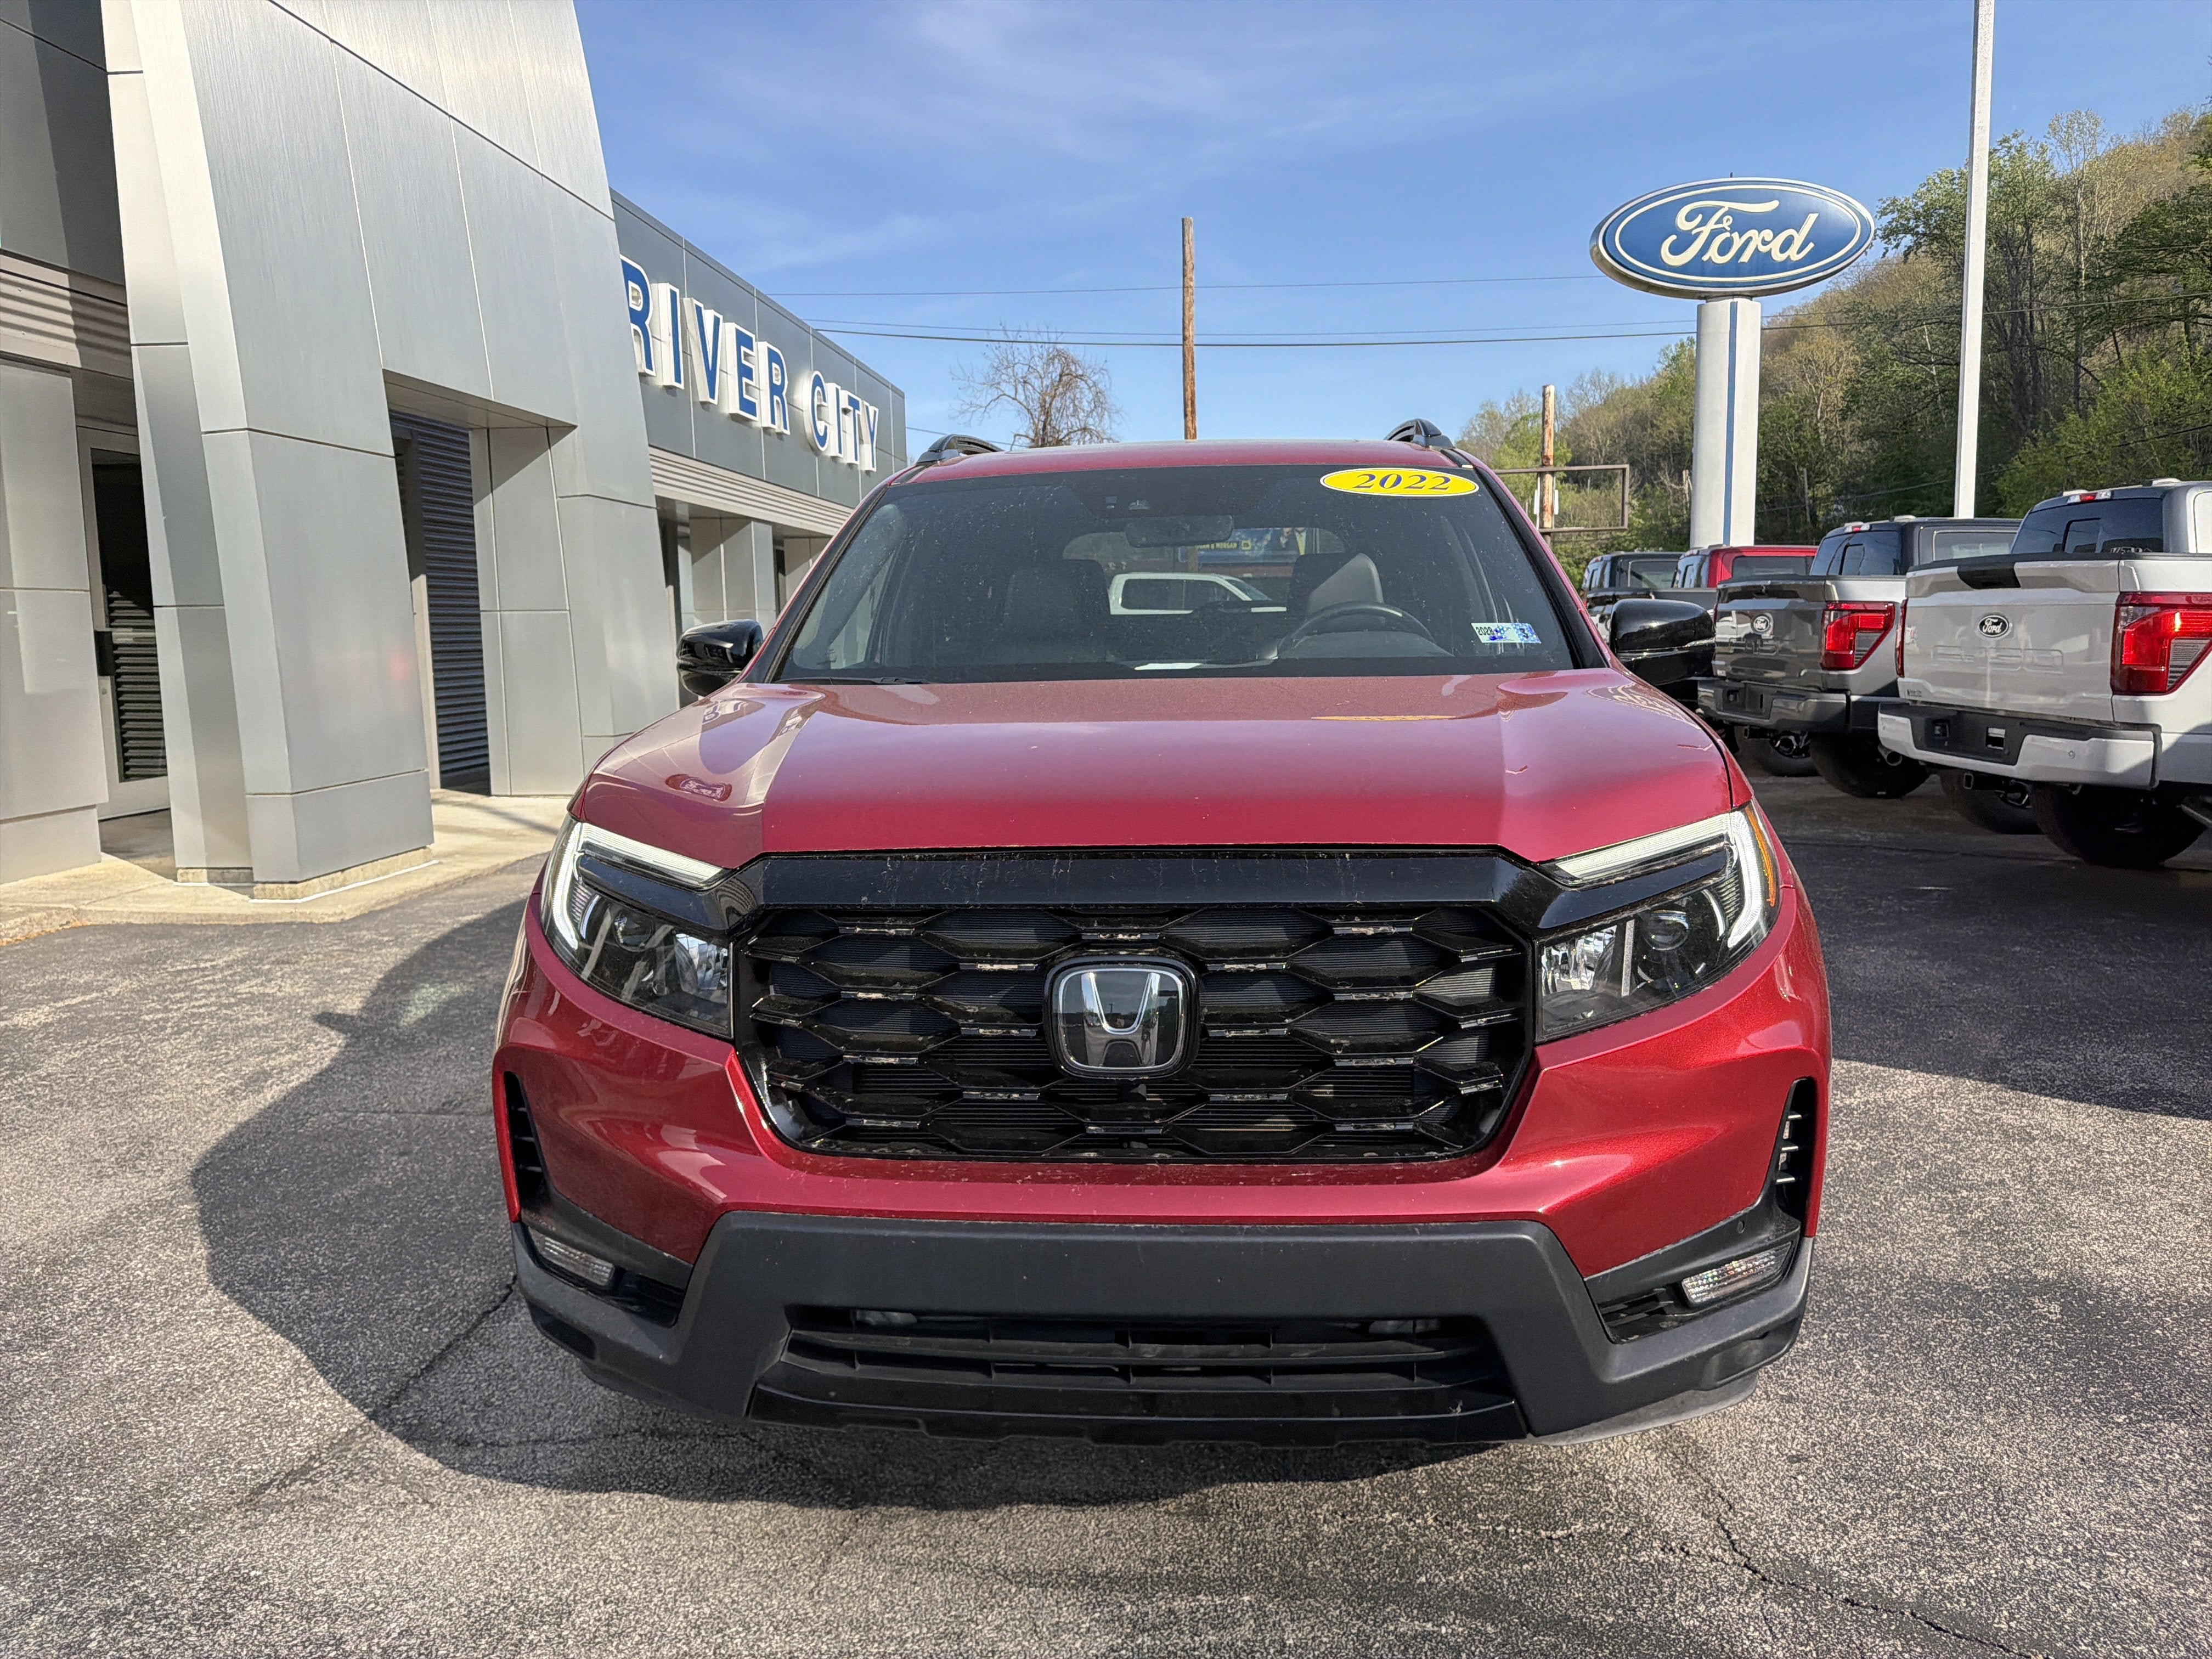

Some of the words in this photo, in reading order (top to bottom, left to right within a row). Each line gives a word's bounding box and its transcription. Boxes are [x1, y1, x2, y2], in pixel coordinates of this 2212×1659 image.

[1661, 200, 1819, 266] Ford
[620, 254, 790, 435] RIVER
[807, 371, 879, 472] CITY
[1352, 473, 1451, 490] 2022
[1982, 617, 2002, 634] Ford
